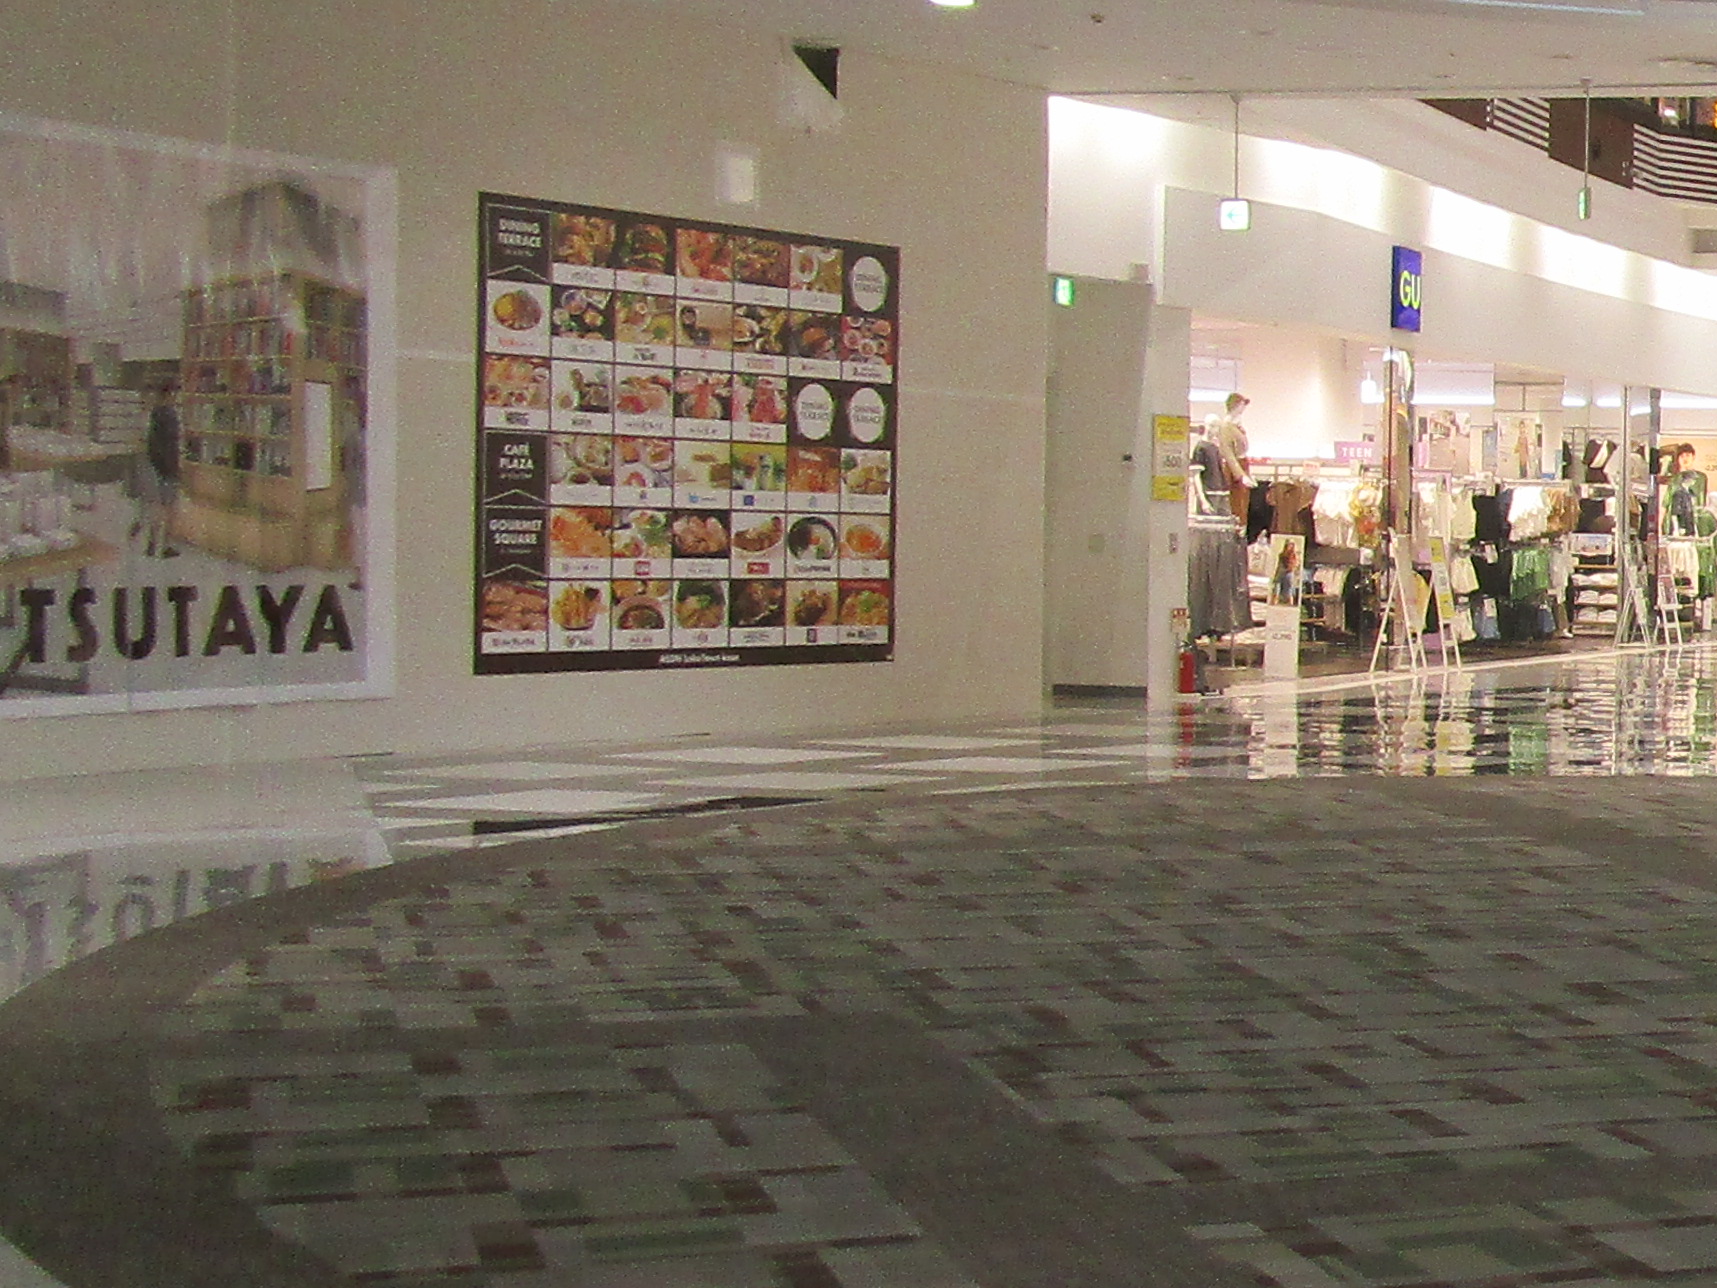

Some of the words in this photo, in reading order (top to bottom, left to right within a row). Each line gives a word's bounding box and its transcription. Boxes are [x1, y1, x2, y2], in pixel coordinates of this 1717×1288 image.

[1400, 270, 1421, 310] GU
[1341, 446, 1373, 458] TEEN
[20, 583, 354, 665] TSUTAYA
